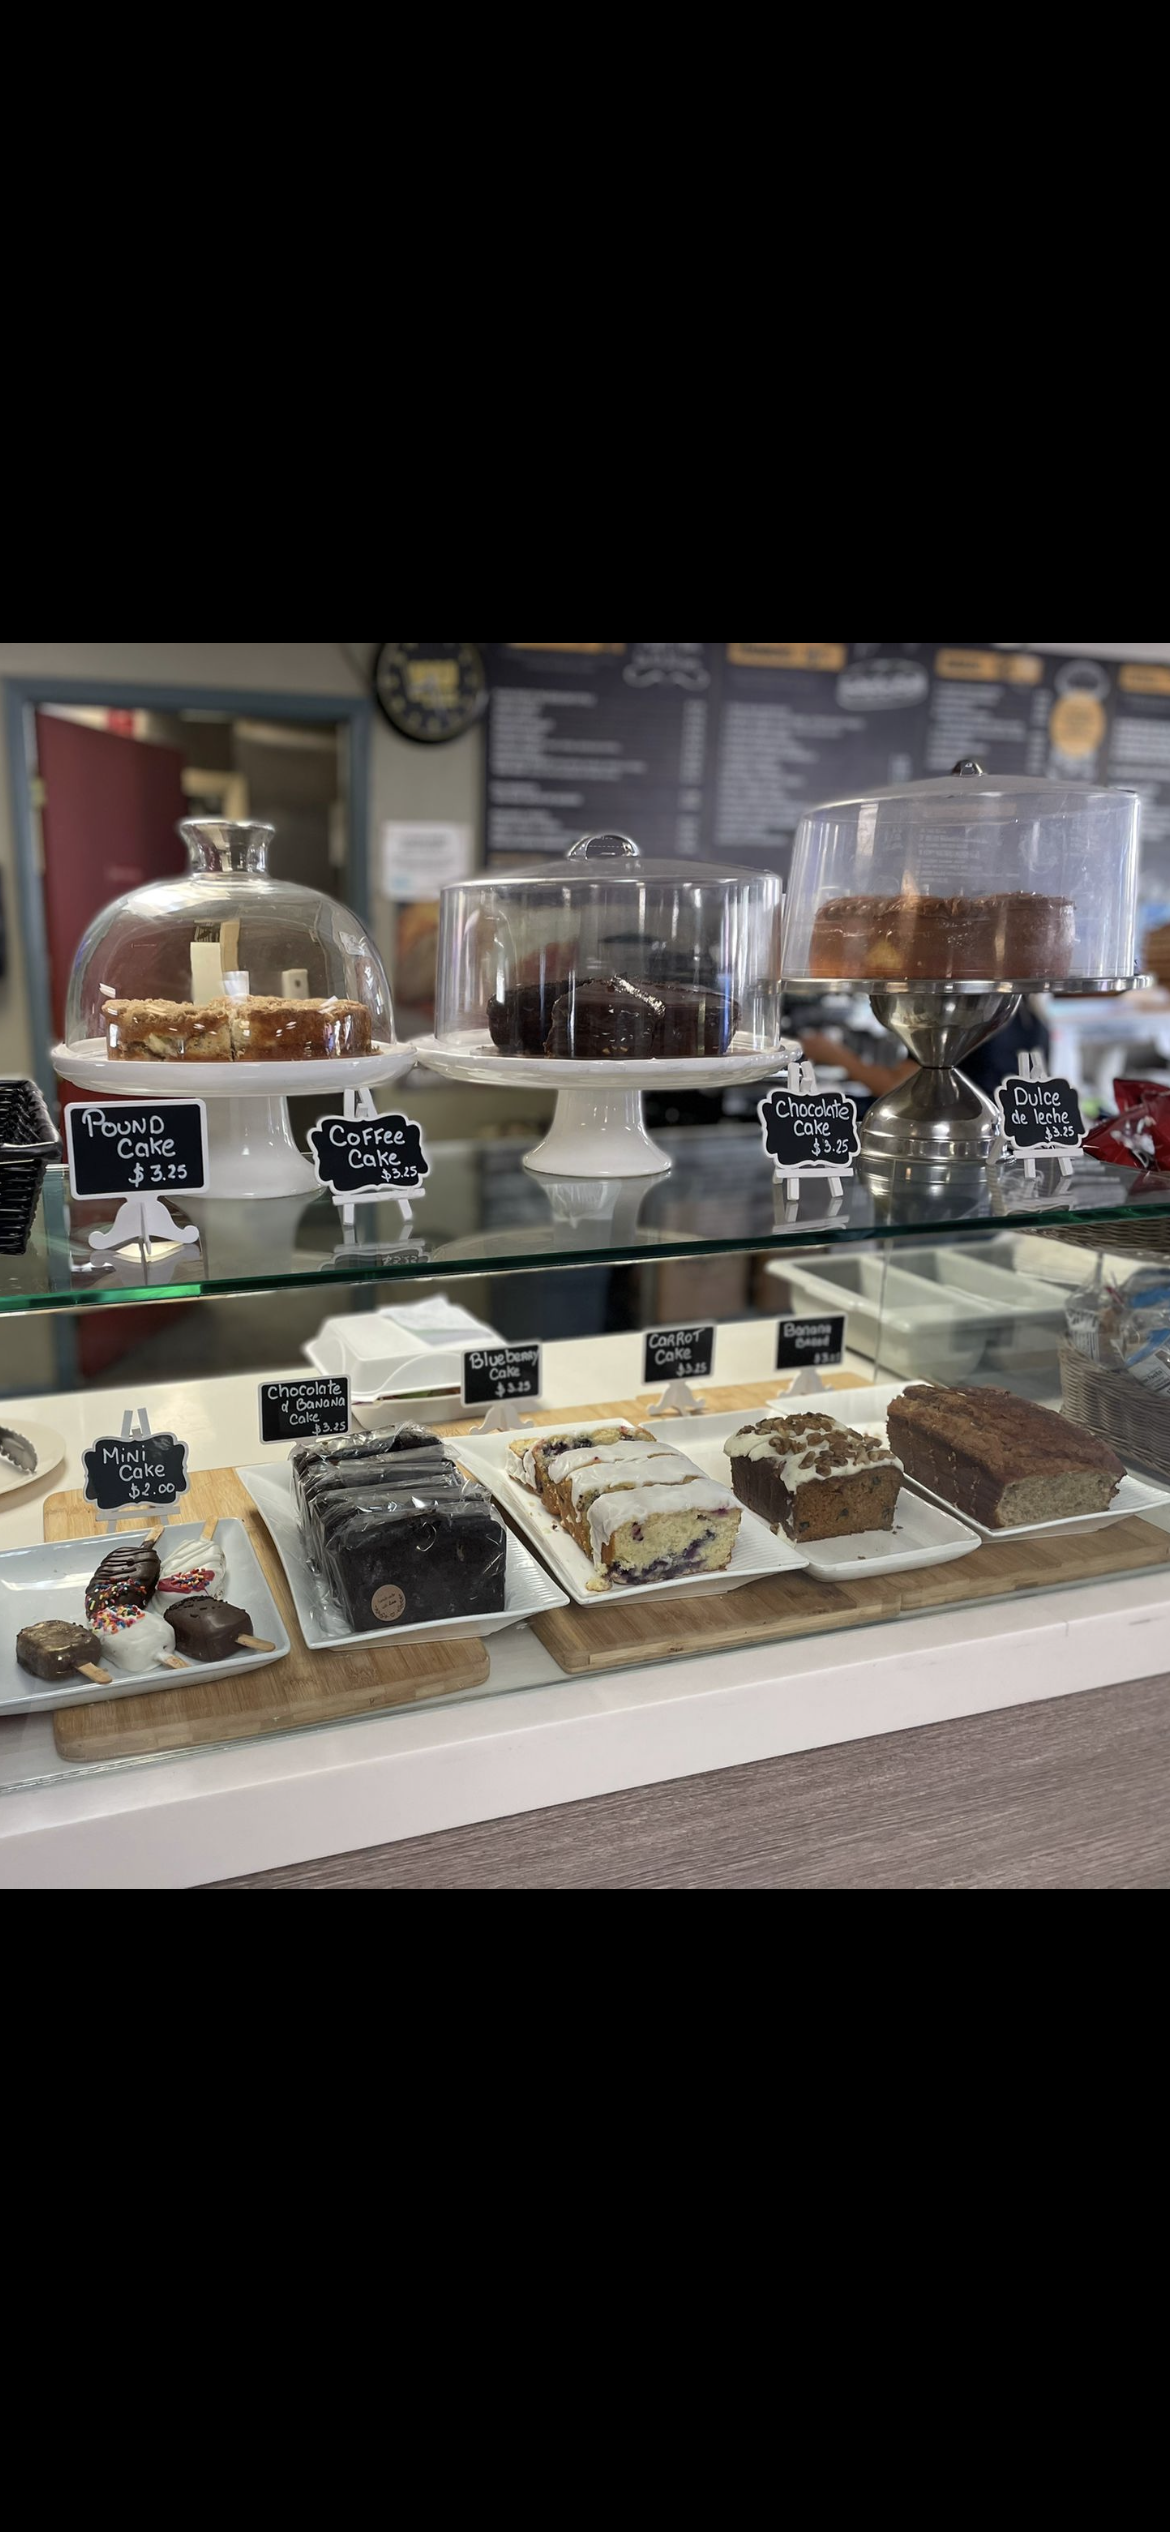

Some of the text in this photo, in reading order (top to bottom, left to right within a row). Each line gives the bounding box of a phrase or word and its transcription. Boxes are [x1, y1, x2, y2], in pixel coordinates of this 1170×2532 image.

[1014, 1086, 1061, 1106] Dulce
[775, 1096, 850, 1120] Chocolate
[1011, 1107, 1070, 1125] de leche
[793, 1118, 831, 1136] Cake
[1045, 1125, 1075, 1142] $3.25
[117, 1137, 176, 1159] Cake
[348, 1149, 401, 1169] Cake
[381, 1165, 418, 1182] $3.25
[654, 1347, 693, 1365] Cake
[489, 1365, 521, 1381] Cake
[267, 1379, 343, 1400] Chocolate
[289, 1411, 321, 1426] Cake
[119, 1463, 166, 1482] Cake
[128, 1482, 176, 1500] $2.00
